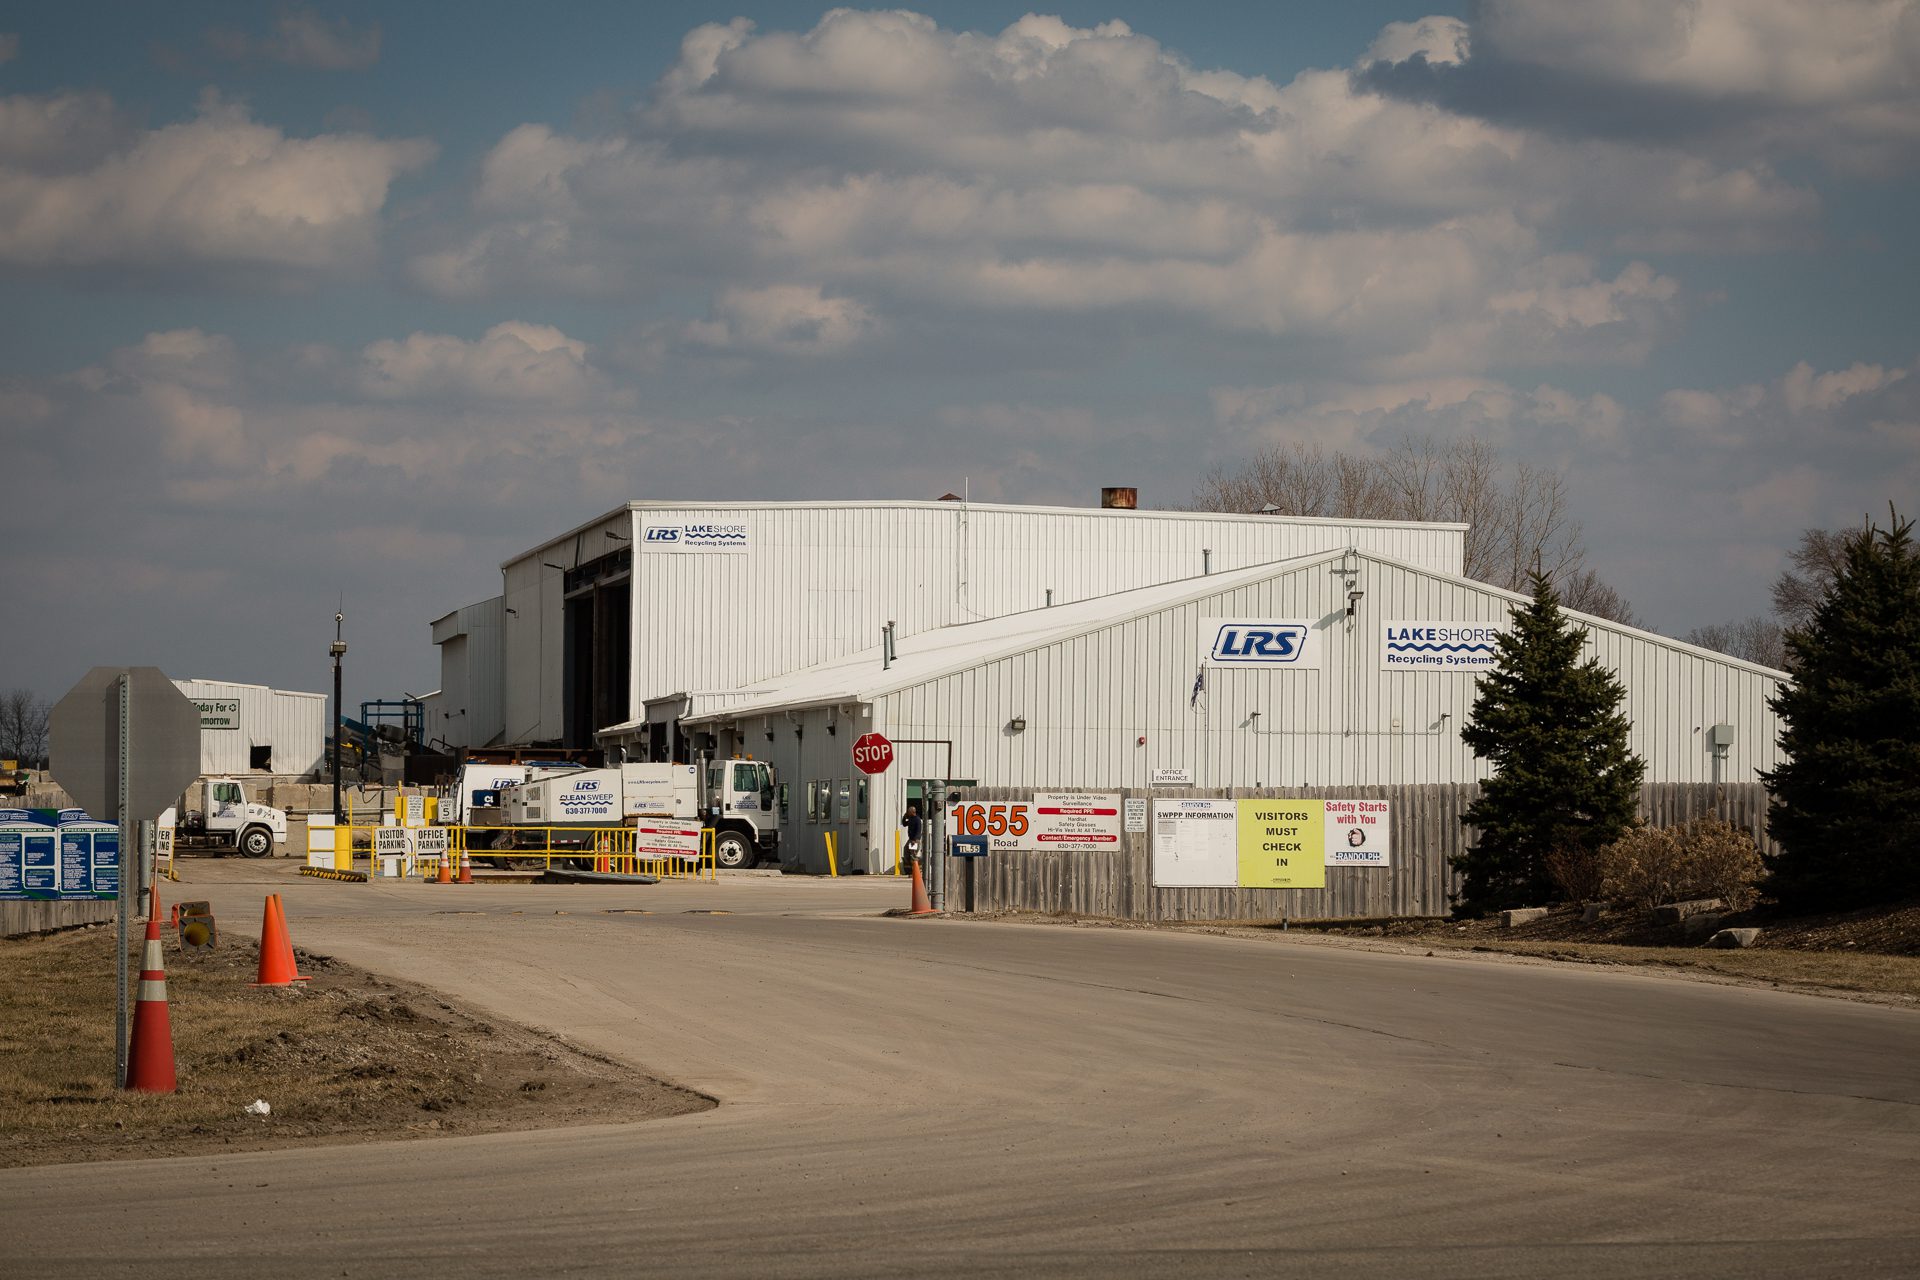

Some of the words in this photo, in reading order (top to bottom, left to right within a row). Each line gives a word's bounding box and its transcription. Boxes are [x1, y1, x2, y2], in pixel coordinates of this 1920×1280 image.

[685, 525, 746, 533] LAKESHORE
[647, 529, 679, 541] LRS
[1387, 628, 1495, 641] LAKESHORE
[1219, 630, 1298, 656] LRS
[1387, 654, 1443, 665] Recycling
[1446, 654, 1495, 665] Systems
[216, 703, 227, 712] For
[855, 744, 890, 763] STOP
[575, 782, 599, 790] LRS
[565, 807, 607, 815] 630-377-7000
[1326, 802, 1356, 813] Safety
[1359, 802, 1388, 812] Starts
[443, 808, 450, 817] 5
[1255, 812, 1308, 821] VISITORS
[951, 804, 1029, 836] 1655
[1337, 815, 1357, 824] with
[1360, 815, 1376, 824] You
[379, 830, 404, 839] VISITOR
[418, 830, 444, 839] OFFICE
[1266, 828, 1298, 836] MUST
[379, 840, 406, 849] PARKING
[418, 840, 445, 849] PARKING
[993, 839, 1018, 847] Road
[1262, 843, 1302, 851] CHECK
[1338, 852, 1379, 860] RANDOLPH
[1276, 858, 1288, 866] IN
